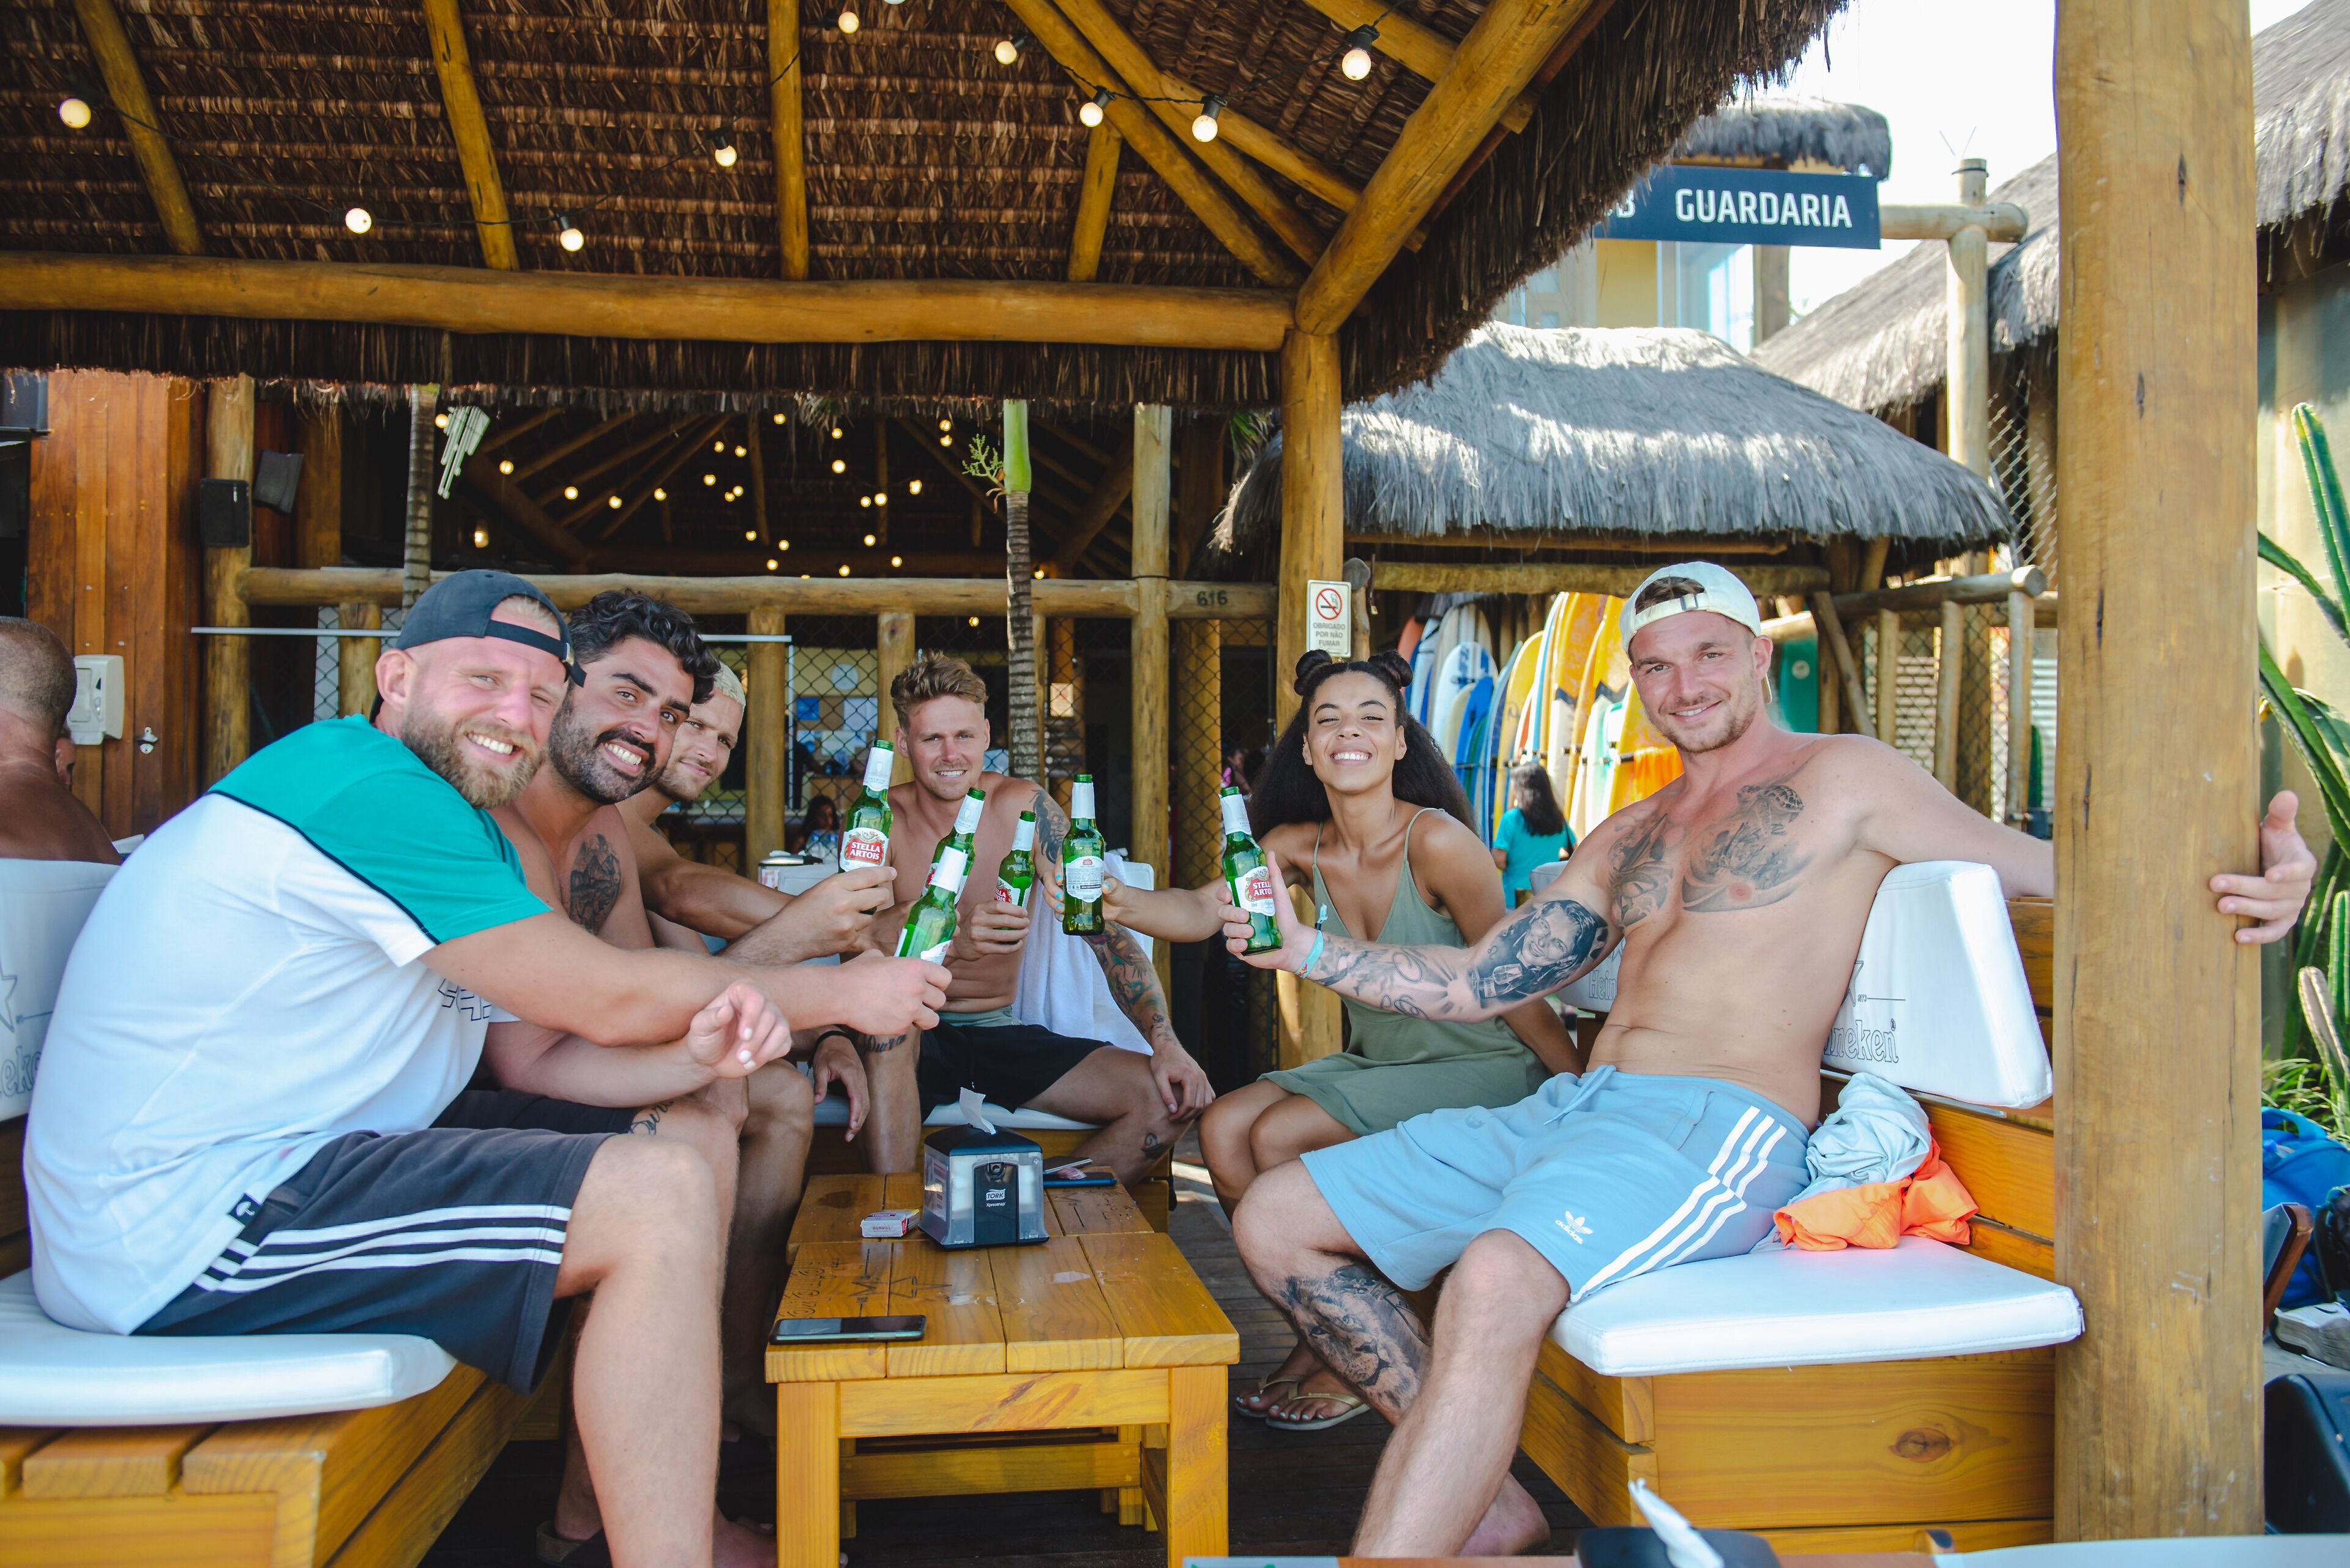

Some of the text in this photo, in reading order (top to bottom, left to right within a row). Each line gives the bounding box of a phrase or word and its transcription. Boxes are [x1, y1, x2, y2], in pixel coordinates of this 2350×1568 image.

[1675, 188, 1852, 228] GUARDARIA
[1196, 589, 1228, 607] 616
[850, 849, 879, 860] ARTOIS
[851, 842, 880, 853] STELLA
[1254, 888, 1272, 897] ARTO
[1555, 1219, 1583, 1244] adidas
